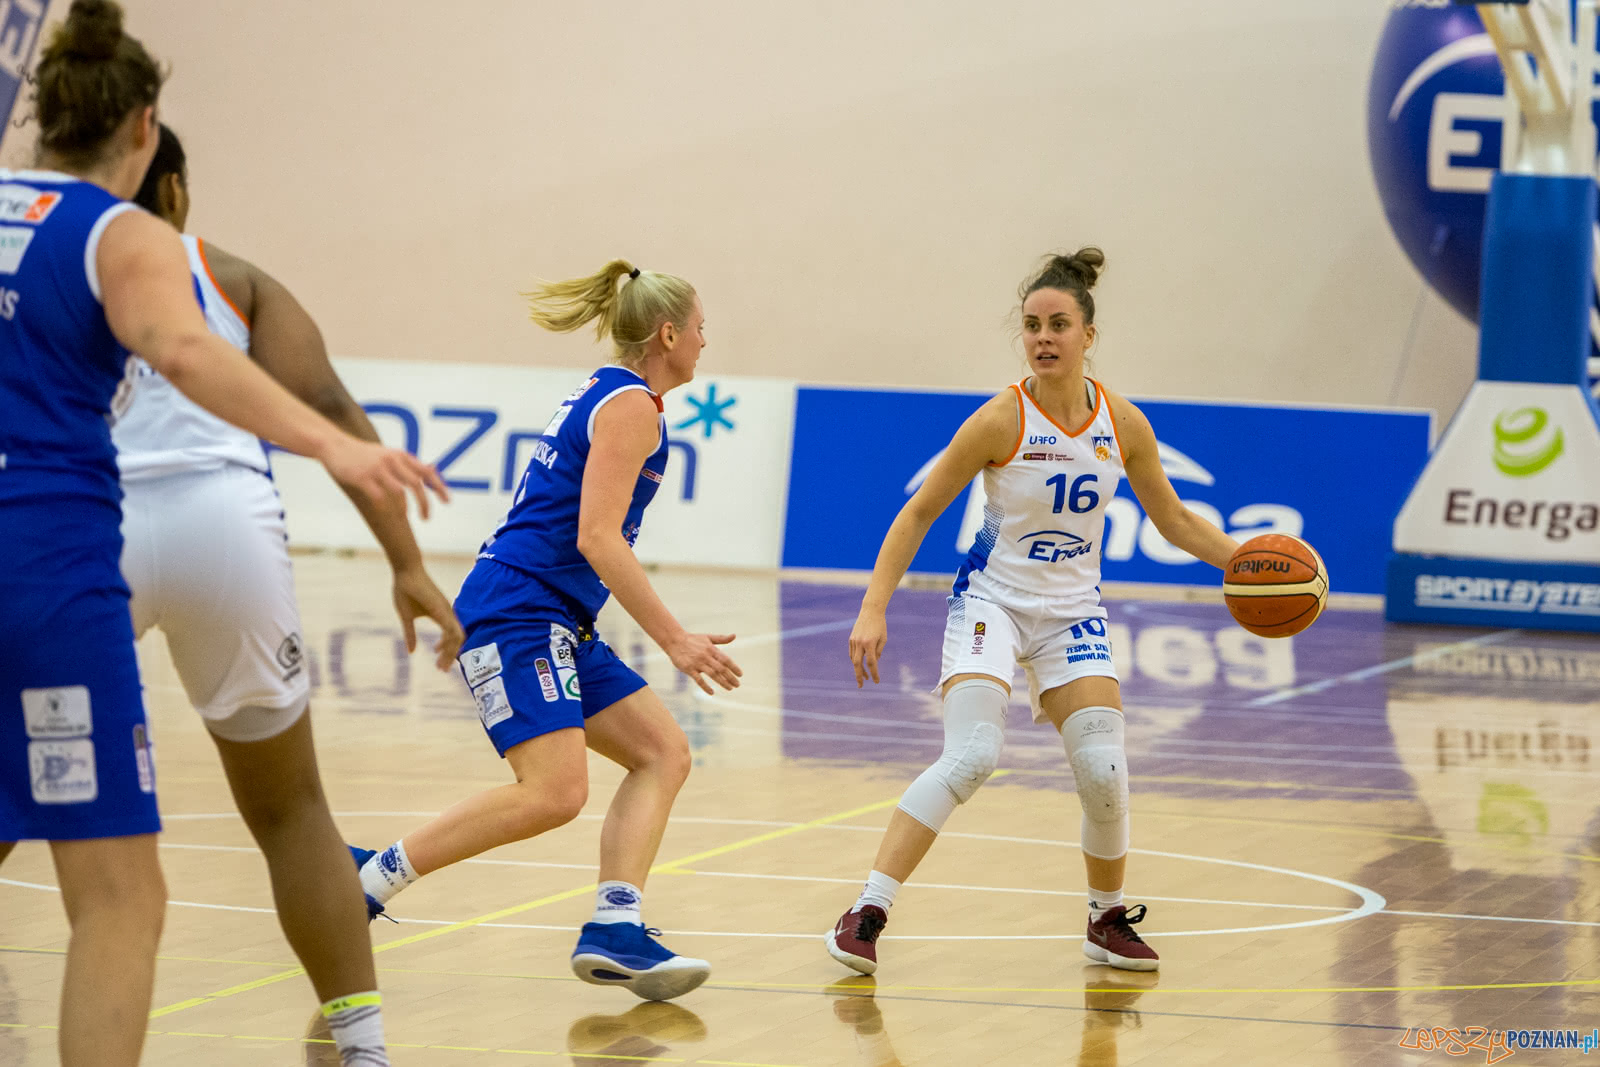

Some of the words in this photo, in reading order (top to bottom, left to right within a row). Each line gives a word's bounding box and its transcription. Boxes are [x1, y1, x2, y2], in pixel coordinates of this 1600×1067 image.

[1046, 473, 1099, 514] 16
[1443, 489, 1599, 541] Energa
[1028, 540, 1092, 563] Enea
[1233, 559, 1291, 574] molten
